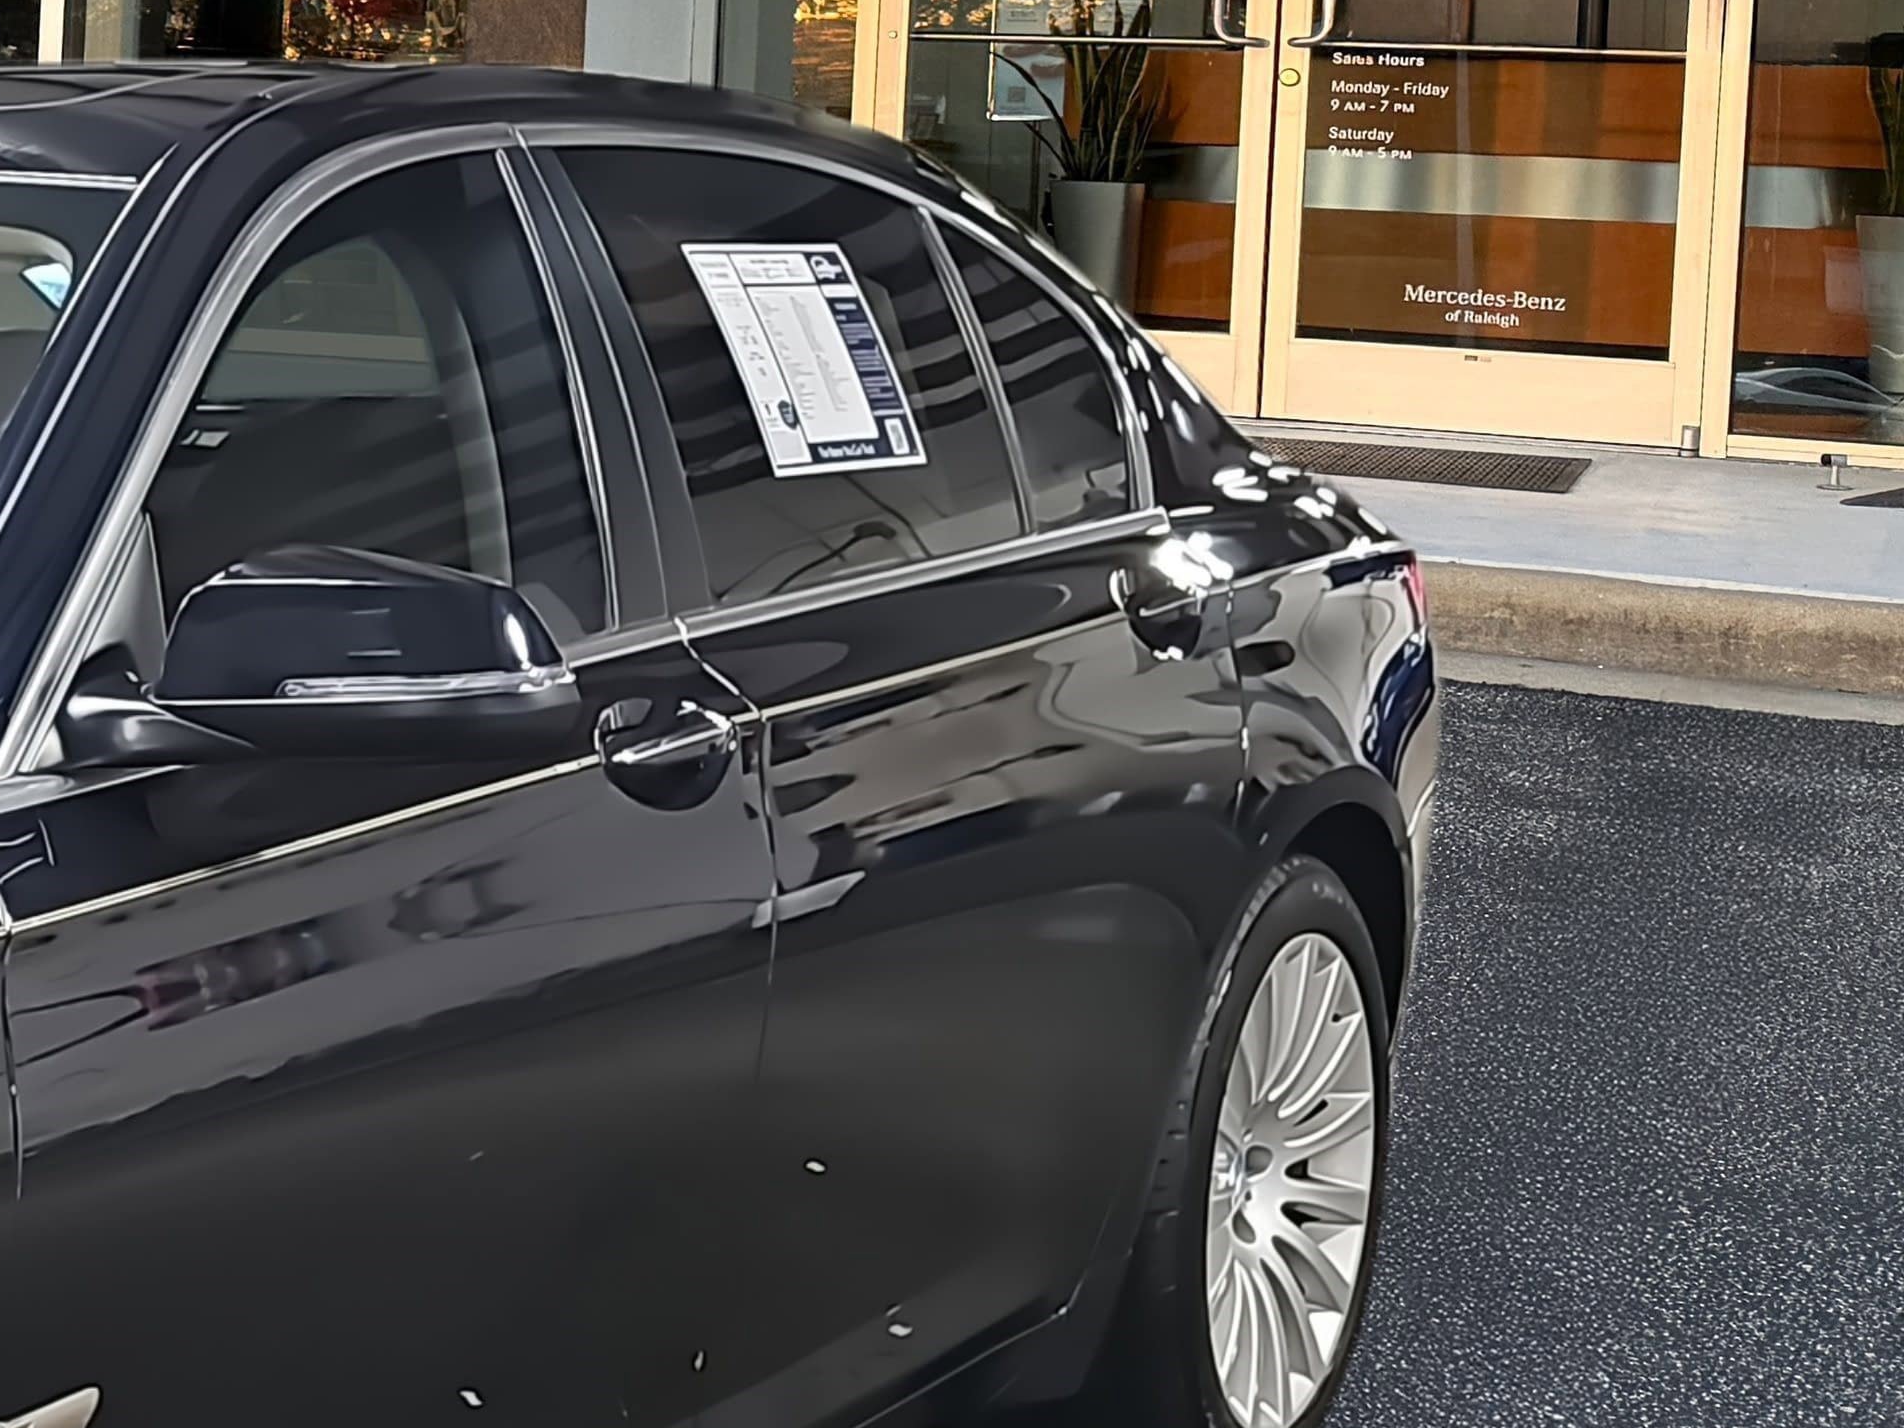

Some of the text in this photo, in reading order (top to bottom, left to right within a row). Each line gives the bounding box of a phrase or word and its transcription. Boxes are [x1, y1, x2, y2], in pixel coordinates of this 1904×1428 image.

[1378, 53, 1425, 67] Hours
[1331, 79, 1390, 97] Monday
[1403, 81, 1449, 99] Friday
[1330, 98, 1340, 111] 9
[1343, 101, 1366, 111] AM
[1379, 99, 1389, 112] 7
[1393, 103, 1415, 113] PM
[1328, 126, 1394, 144] Saturday
[1391, 149, 1413, 160] PM
[1403, 283, 1566, 312] Mercedes-Benz
[1445, 309, 1520, 329] of Raleigh
